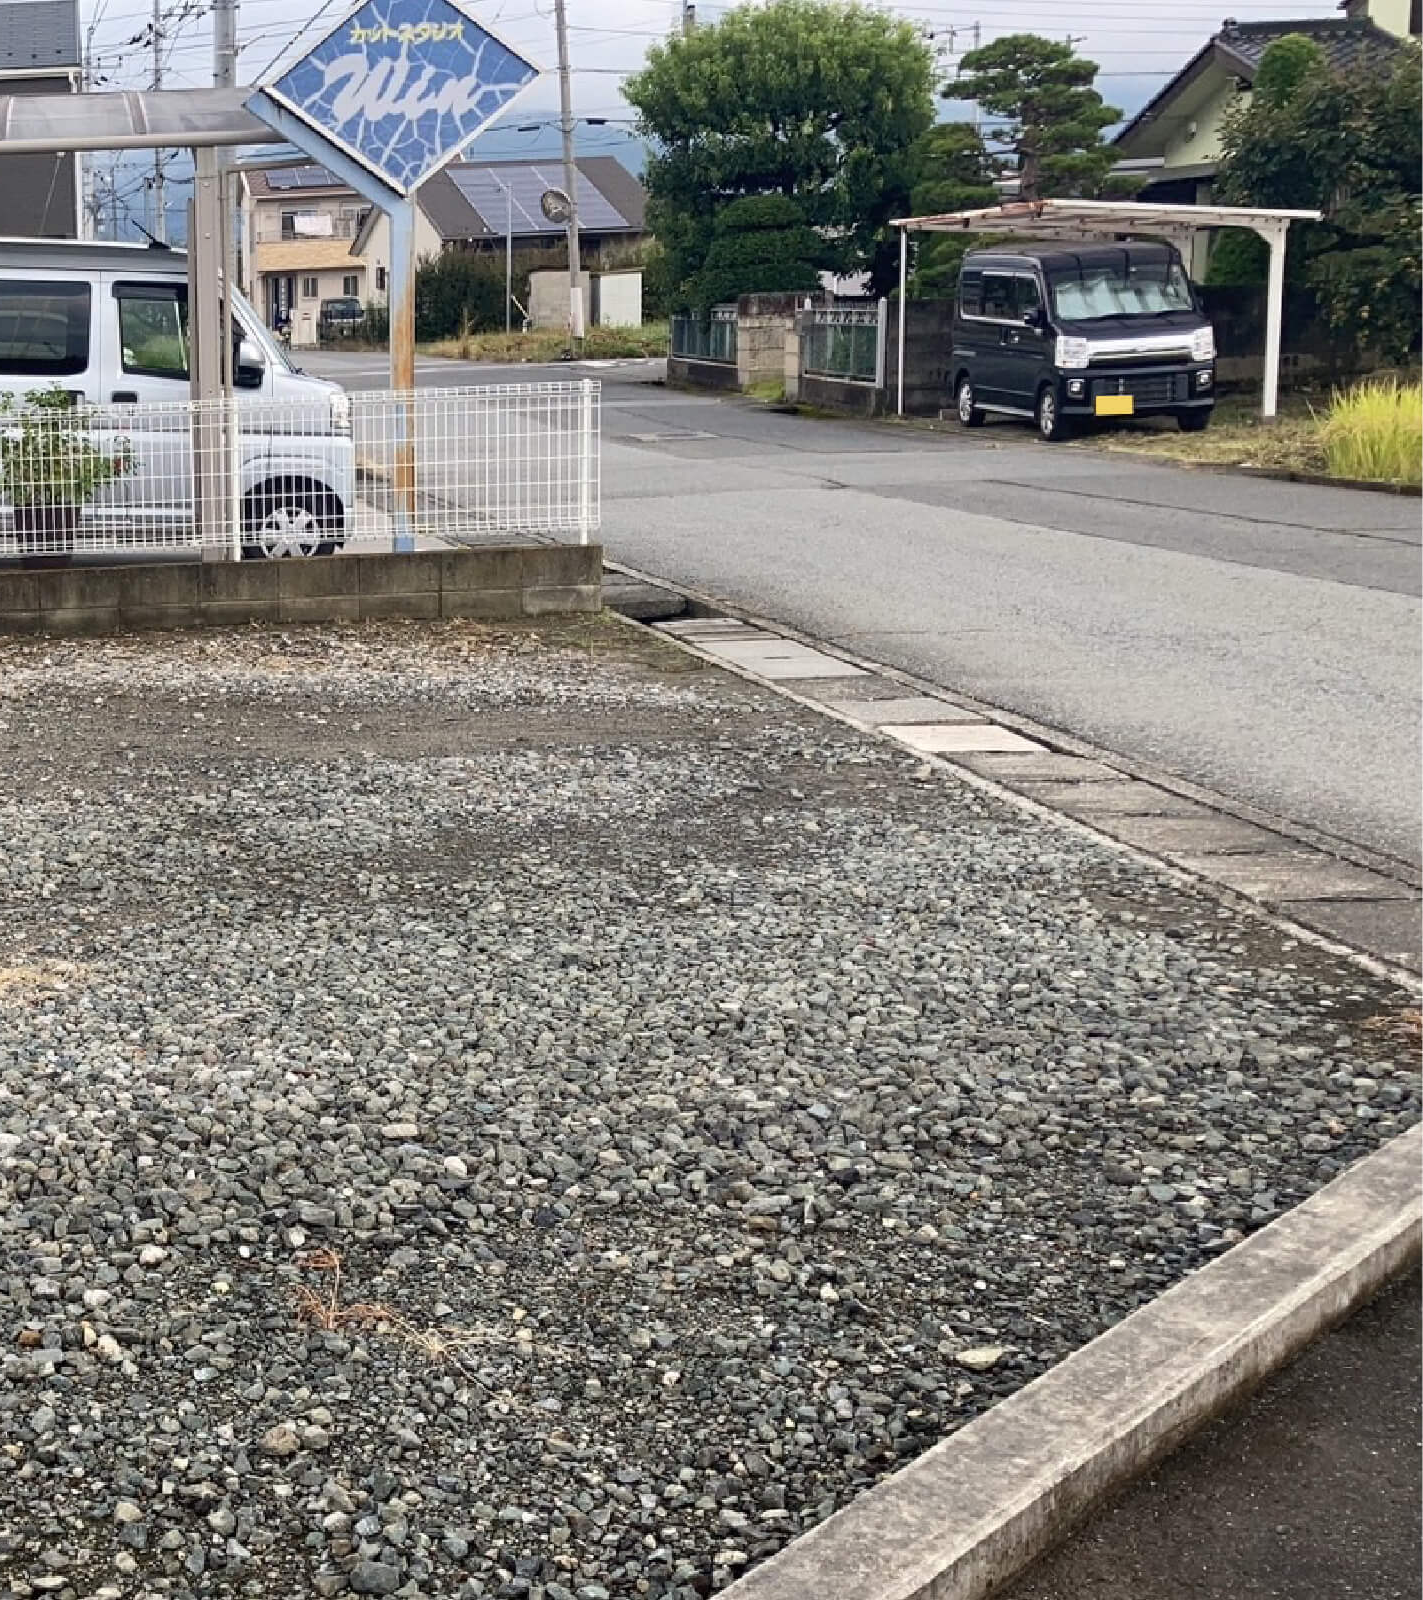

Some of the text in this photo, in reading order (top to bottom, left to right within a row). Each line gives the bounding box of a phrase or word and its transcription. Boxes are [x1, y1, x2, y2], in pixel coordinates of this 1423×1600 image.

[350, 21, 464, 43] カットスタジオ
[324, 54, 484, 124] Win
